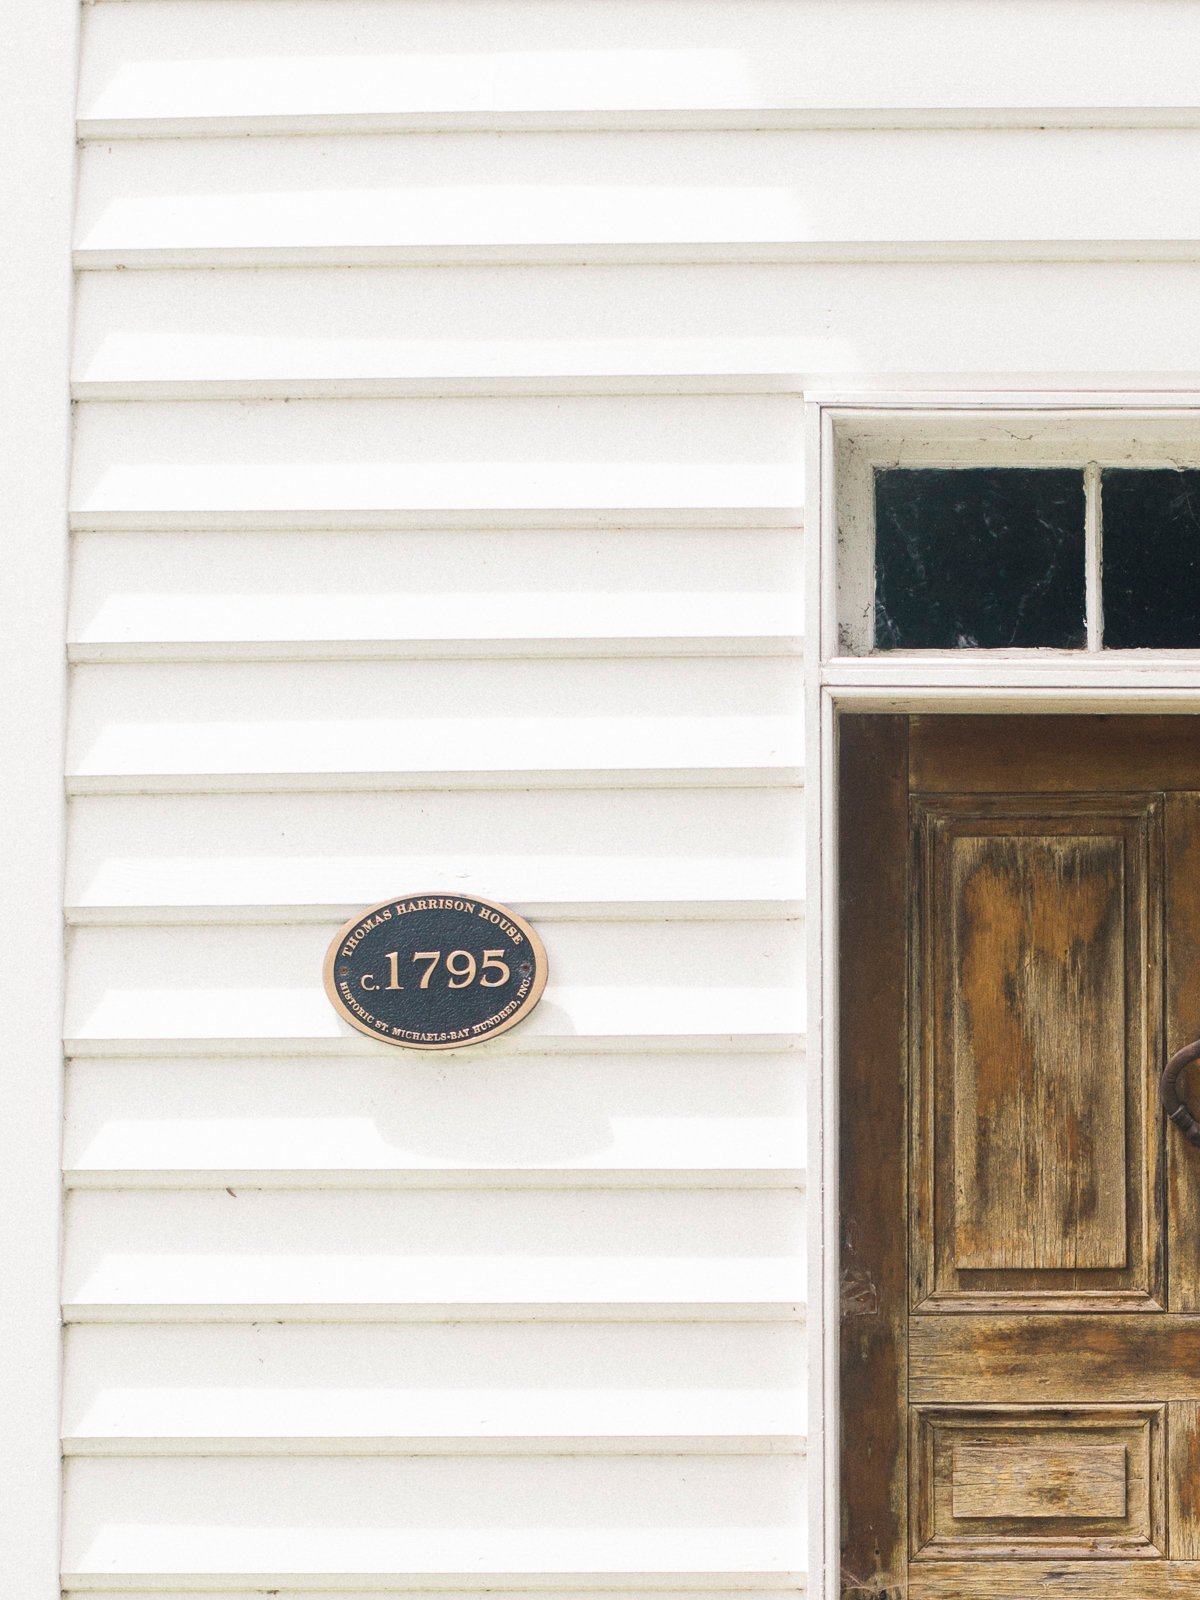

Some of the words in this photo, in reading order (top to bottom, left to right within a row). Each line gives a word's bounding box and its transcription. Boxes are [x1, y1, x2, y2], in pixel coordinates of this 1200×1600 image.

[341, 909, 392, 957] THOMAS
[395, 899, 476, 916] HARRISON
[478, 907, 524, 945] HOUSE
[339, 981, 375, 1024] HISTORIC
[374, 1020, 389, 1033] ST.
[471, 1000, 521, 1034] HUNDRED,
[516, 976, 532, 998] INC.
